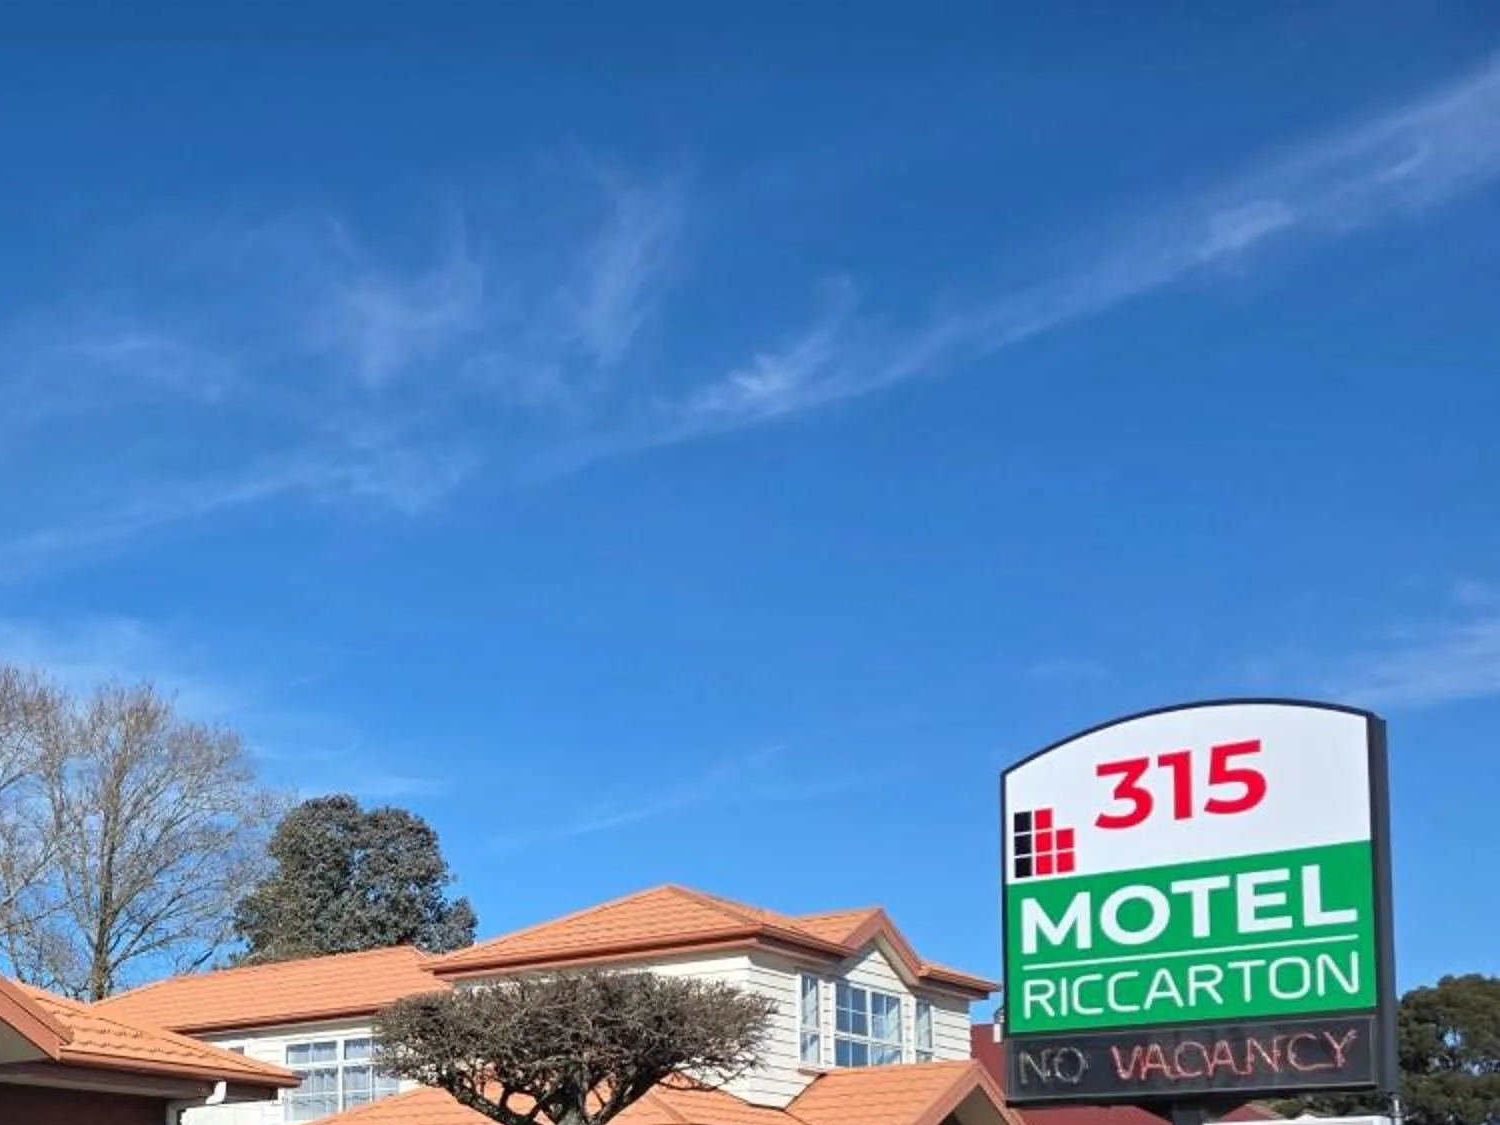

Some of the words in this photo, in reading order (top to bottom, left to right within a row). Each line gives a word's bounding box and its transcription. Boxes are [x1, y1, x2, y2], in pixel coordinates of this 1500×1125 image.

[1094, 739, 1267, 830] 315
[1021, 864, 1358, 955] MOTEL
[1024, 951, 1360, 1019] RICCARTON
[1019, 1047, 1089, 1084] NO
[1112, 1029, 1358, 1080] VACANCY
